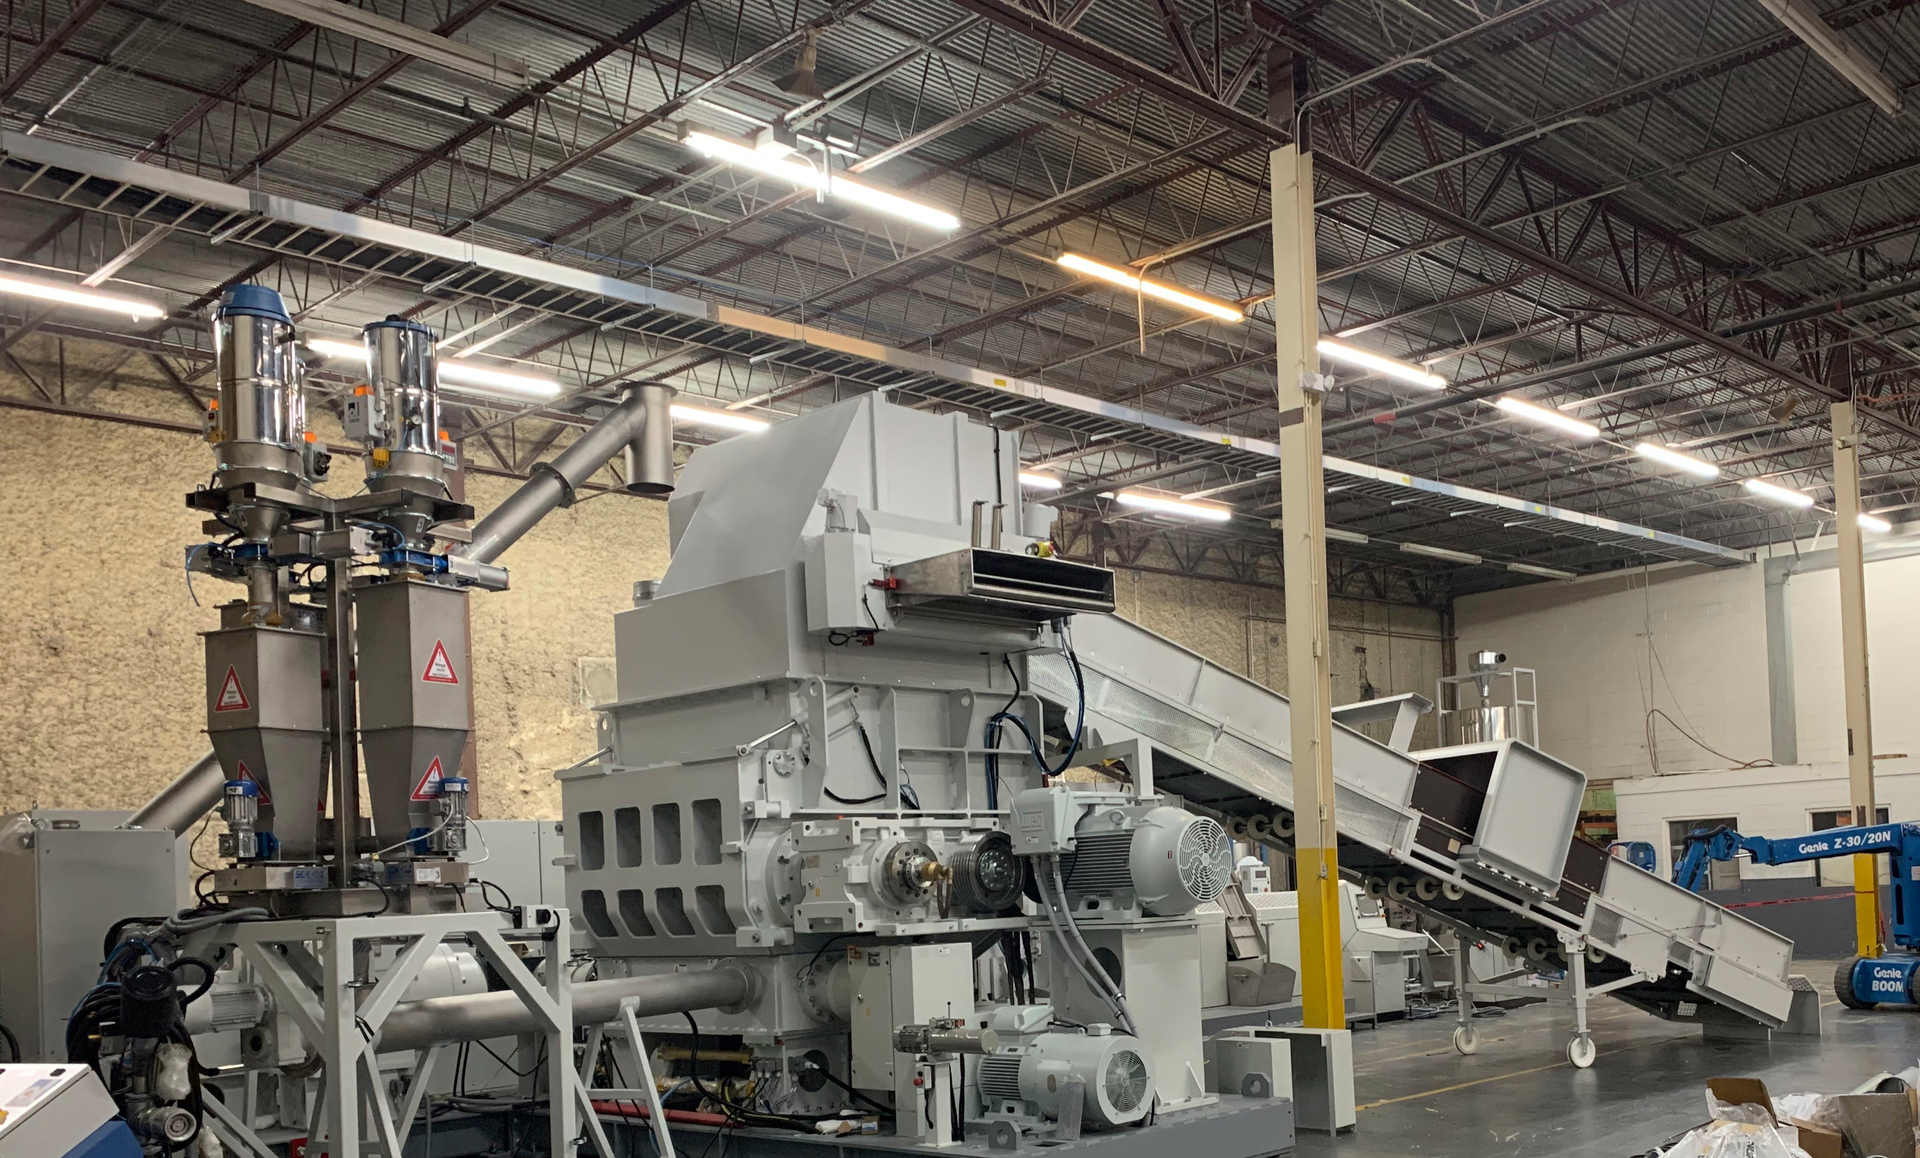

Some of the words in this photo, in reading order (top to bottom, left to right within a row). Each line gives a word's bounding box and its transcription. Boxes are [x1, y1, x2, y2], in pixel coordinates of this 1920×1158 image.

[1799, 842, 1829, 854] Genie
[1834, 831, 1891, 849] Z-30/20N
[435, 870, 441, 879] 3
[233, 878, 239, 887] 4
[1874, 967, 1902, 978] Genie
[1872, 980, 1904, 992] BOOM
